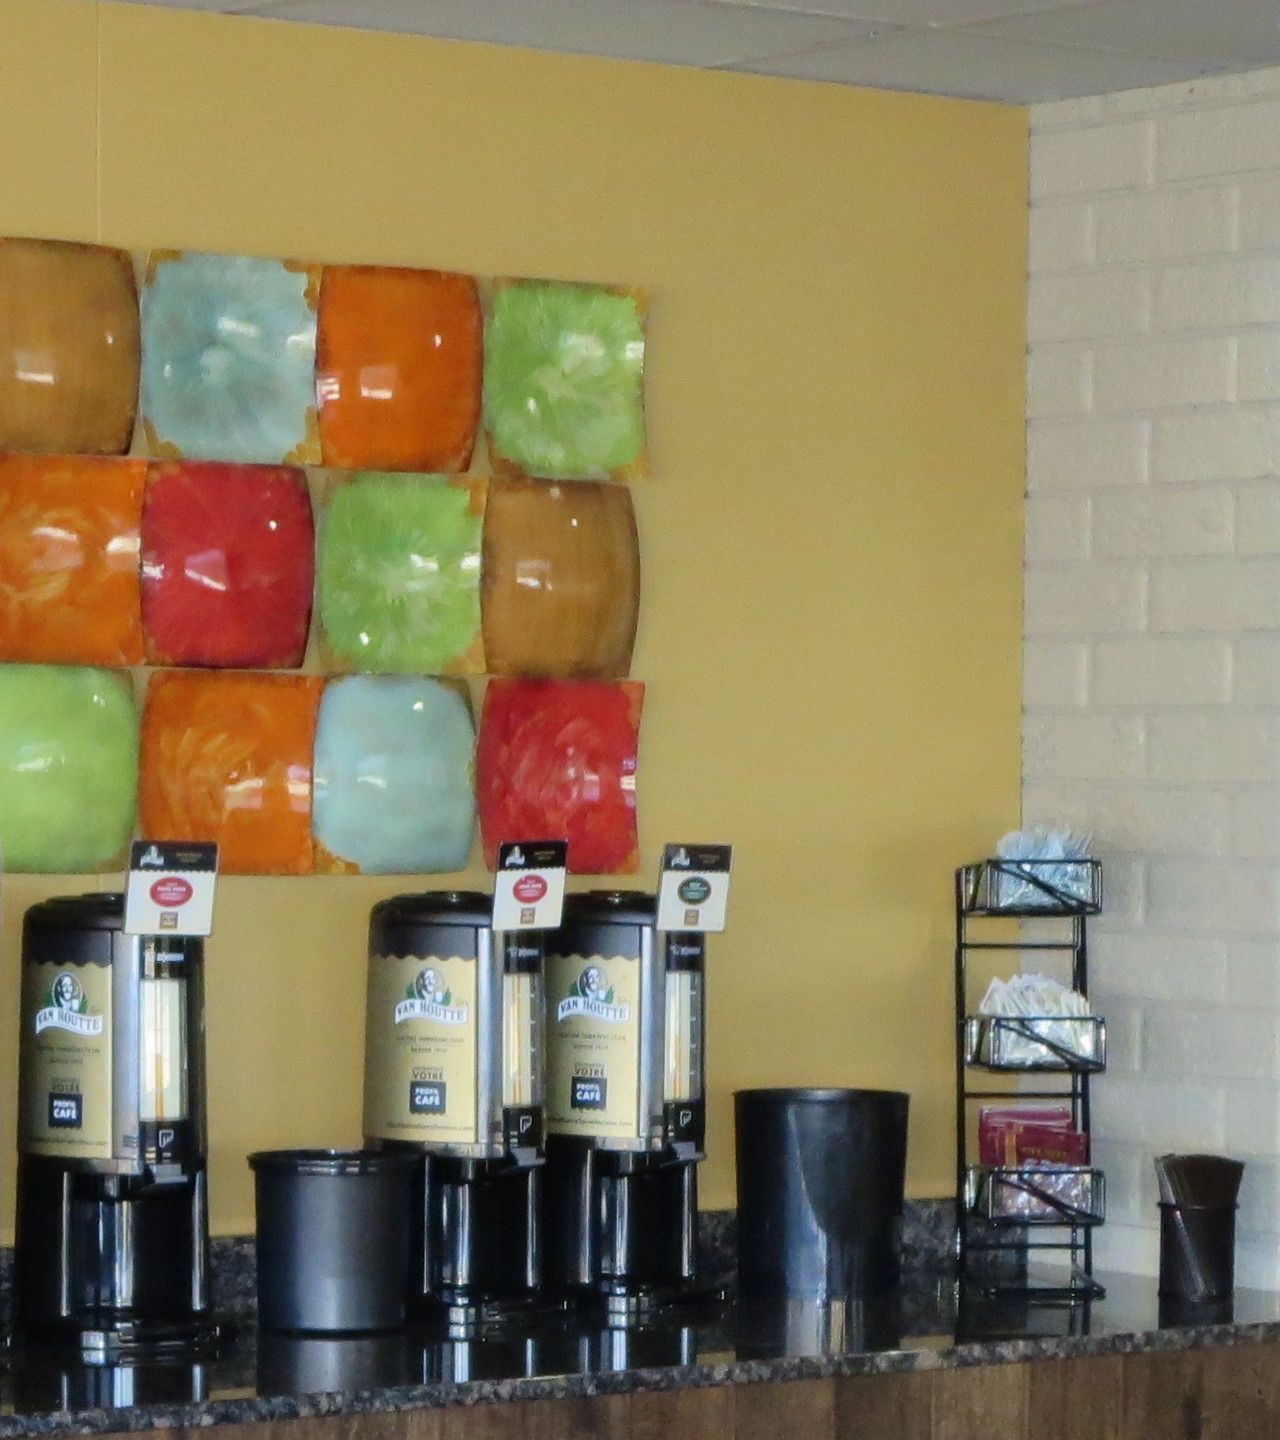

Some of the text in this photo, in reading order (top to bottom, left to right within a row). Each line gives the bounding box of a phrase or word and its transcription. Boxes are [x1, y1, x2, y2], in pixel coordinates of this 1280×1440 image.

[37, 1010, 101, 1031] VAN HOUTTE
[397, 1001, 465, 1022] VAN HOUTTE
[560, 999, 627, 1021] VAN HOUTTE
